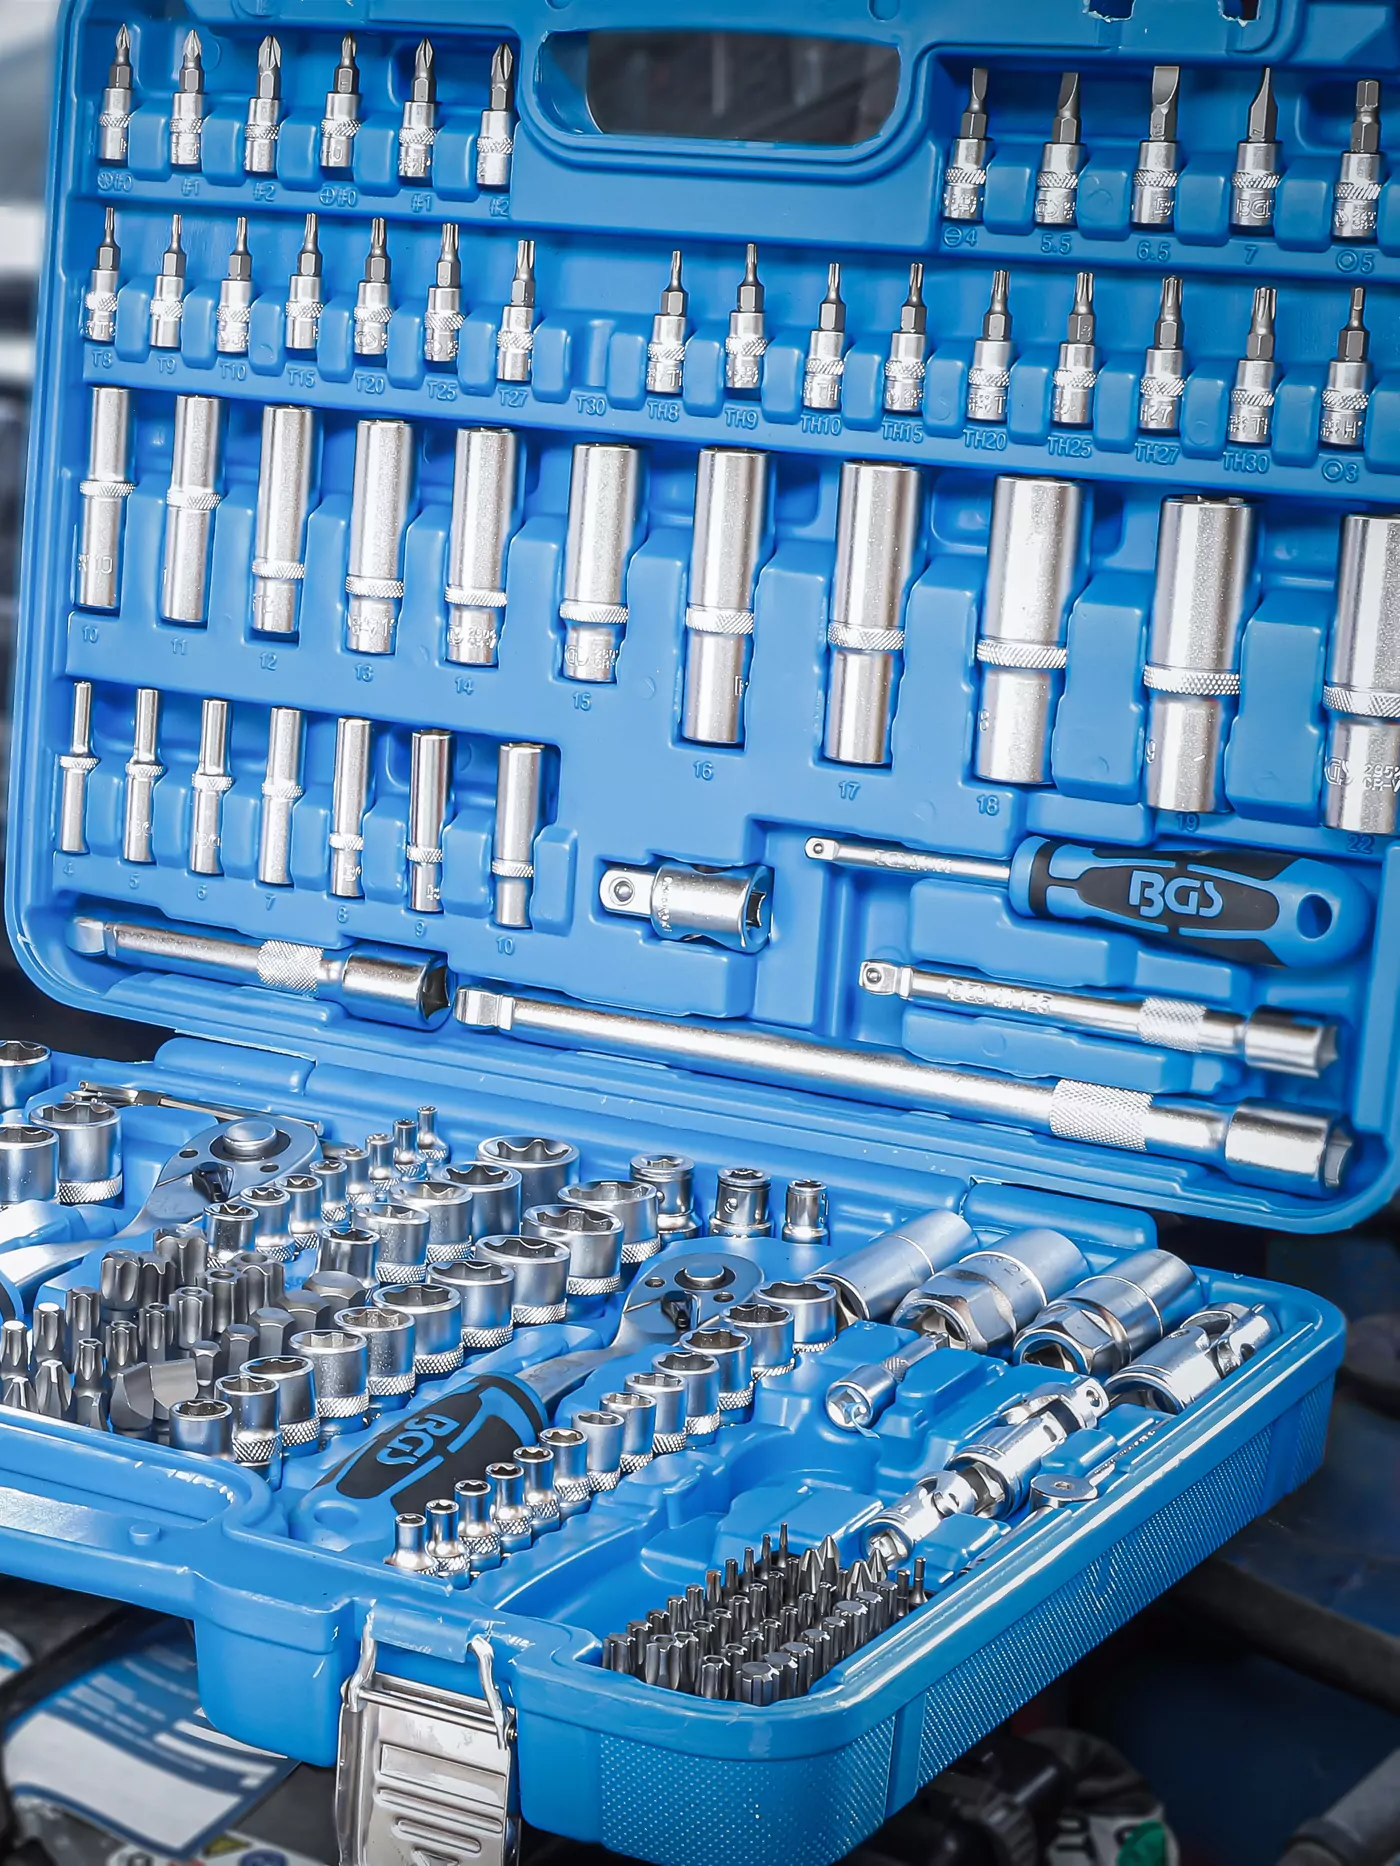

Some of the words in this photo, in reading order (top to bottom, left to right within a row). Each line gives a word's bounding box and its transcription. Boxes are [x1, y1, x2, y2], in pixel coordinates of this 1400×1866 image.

[181, 178, 199, 197] #1
[252, 182, 276, 201] #2
[336, 189, 357, 207] #0
[410, 193, 432, 213] #1
[489, 197, 510, 217] #2
[965, 229, 978, 247] 4
[1041, 234, 1072, 255] 5.5
[1137, 241, 1171, 263] 6.5
[1244, 243, 1259, 266] 7
[1360, 253, 1375, 274] 5
[91, 350, 113, 368] T8
[157, 357, 177, 375] T9
[220, 363, 247, 381] T10
[288, 369, 316, 389] T15
[356, 375, 384, 395] T20
[427, 381, 457, 401] T25
[499, 389, 528, 408] T27
[576, 395, 607, 416] T30
[647, 400, 681, 422] TH8
[725, 407, 759, 430] TH9
[801, 414, 842, 436] TH10
[881, 420, 924, 443] TH15
[963, 428, 1007, 451] TH20
[1047, 436, 1093, 458] TH25
[1134, 442, 1180, 466] TH27
[1223, 452, 1270, 473] TH30
[1344, 463, 1359, 483] 3
[82, 624, 99, 643] 10
[170, 637, 188, 656] 11
[259, 652, 278, 671] 12
[354, 663, 375, 682] 13
[454, 676, 474, 695] 14
[572, 691, 592, 711] 15
[692, 760, 714, 781] 16
[838, 781, 861, 801] 17
[976, 793, 1000, 816] 18
[1177, 812, 1200, 833] 19
[1348, 834, 1375, 855] 22
[63, 861, 74, 876] 4
[129, 872, 140, 890] 5
[197, 884, 208, 901] 6
[265, 893, 276, 911] 7
[1128, 869, 1224, 919] BGS
[336, 905, 349, 923] 8
[414, 918, 427, 937] 9
[496, 935, 515, 955] 10
[376, 1413, 460, 1465] BGS
